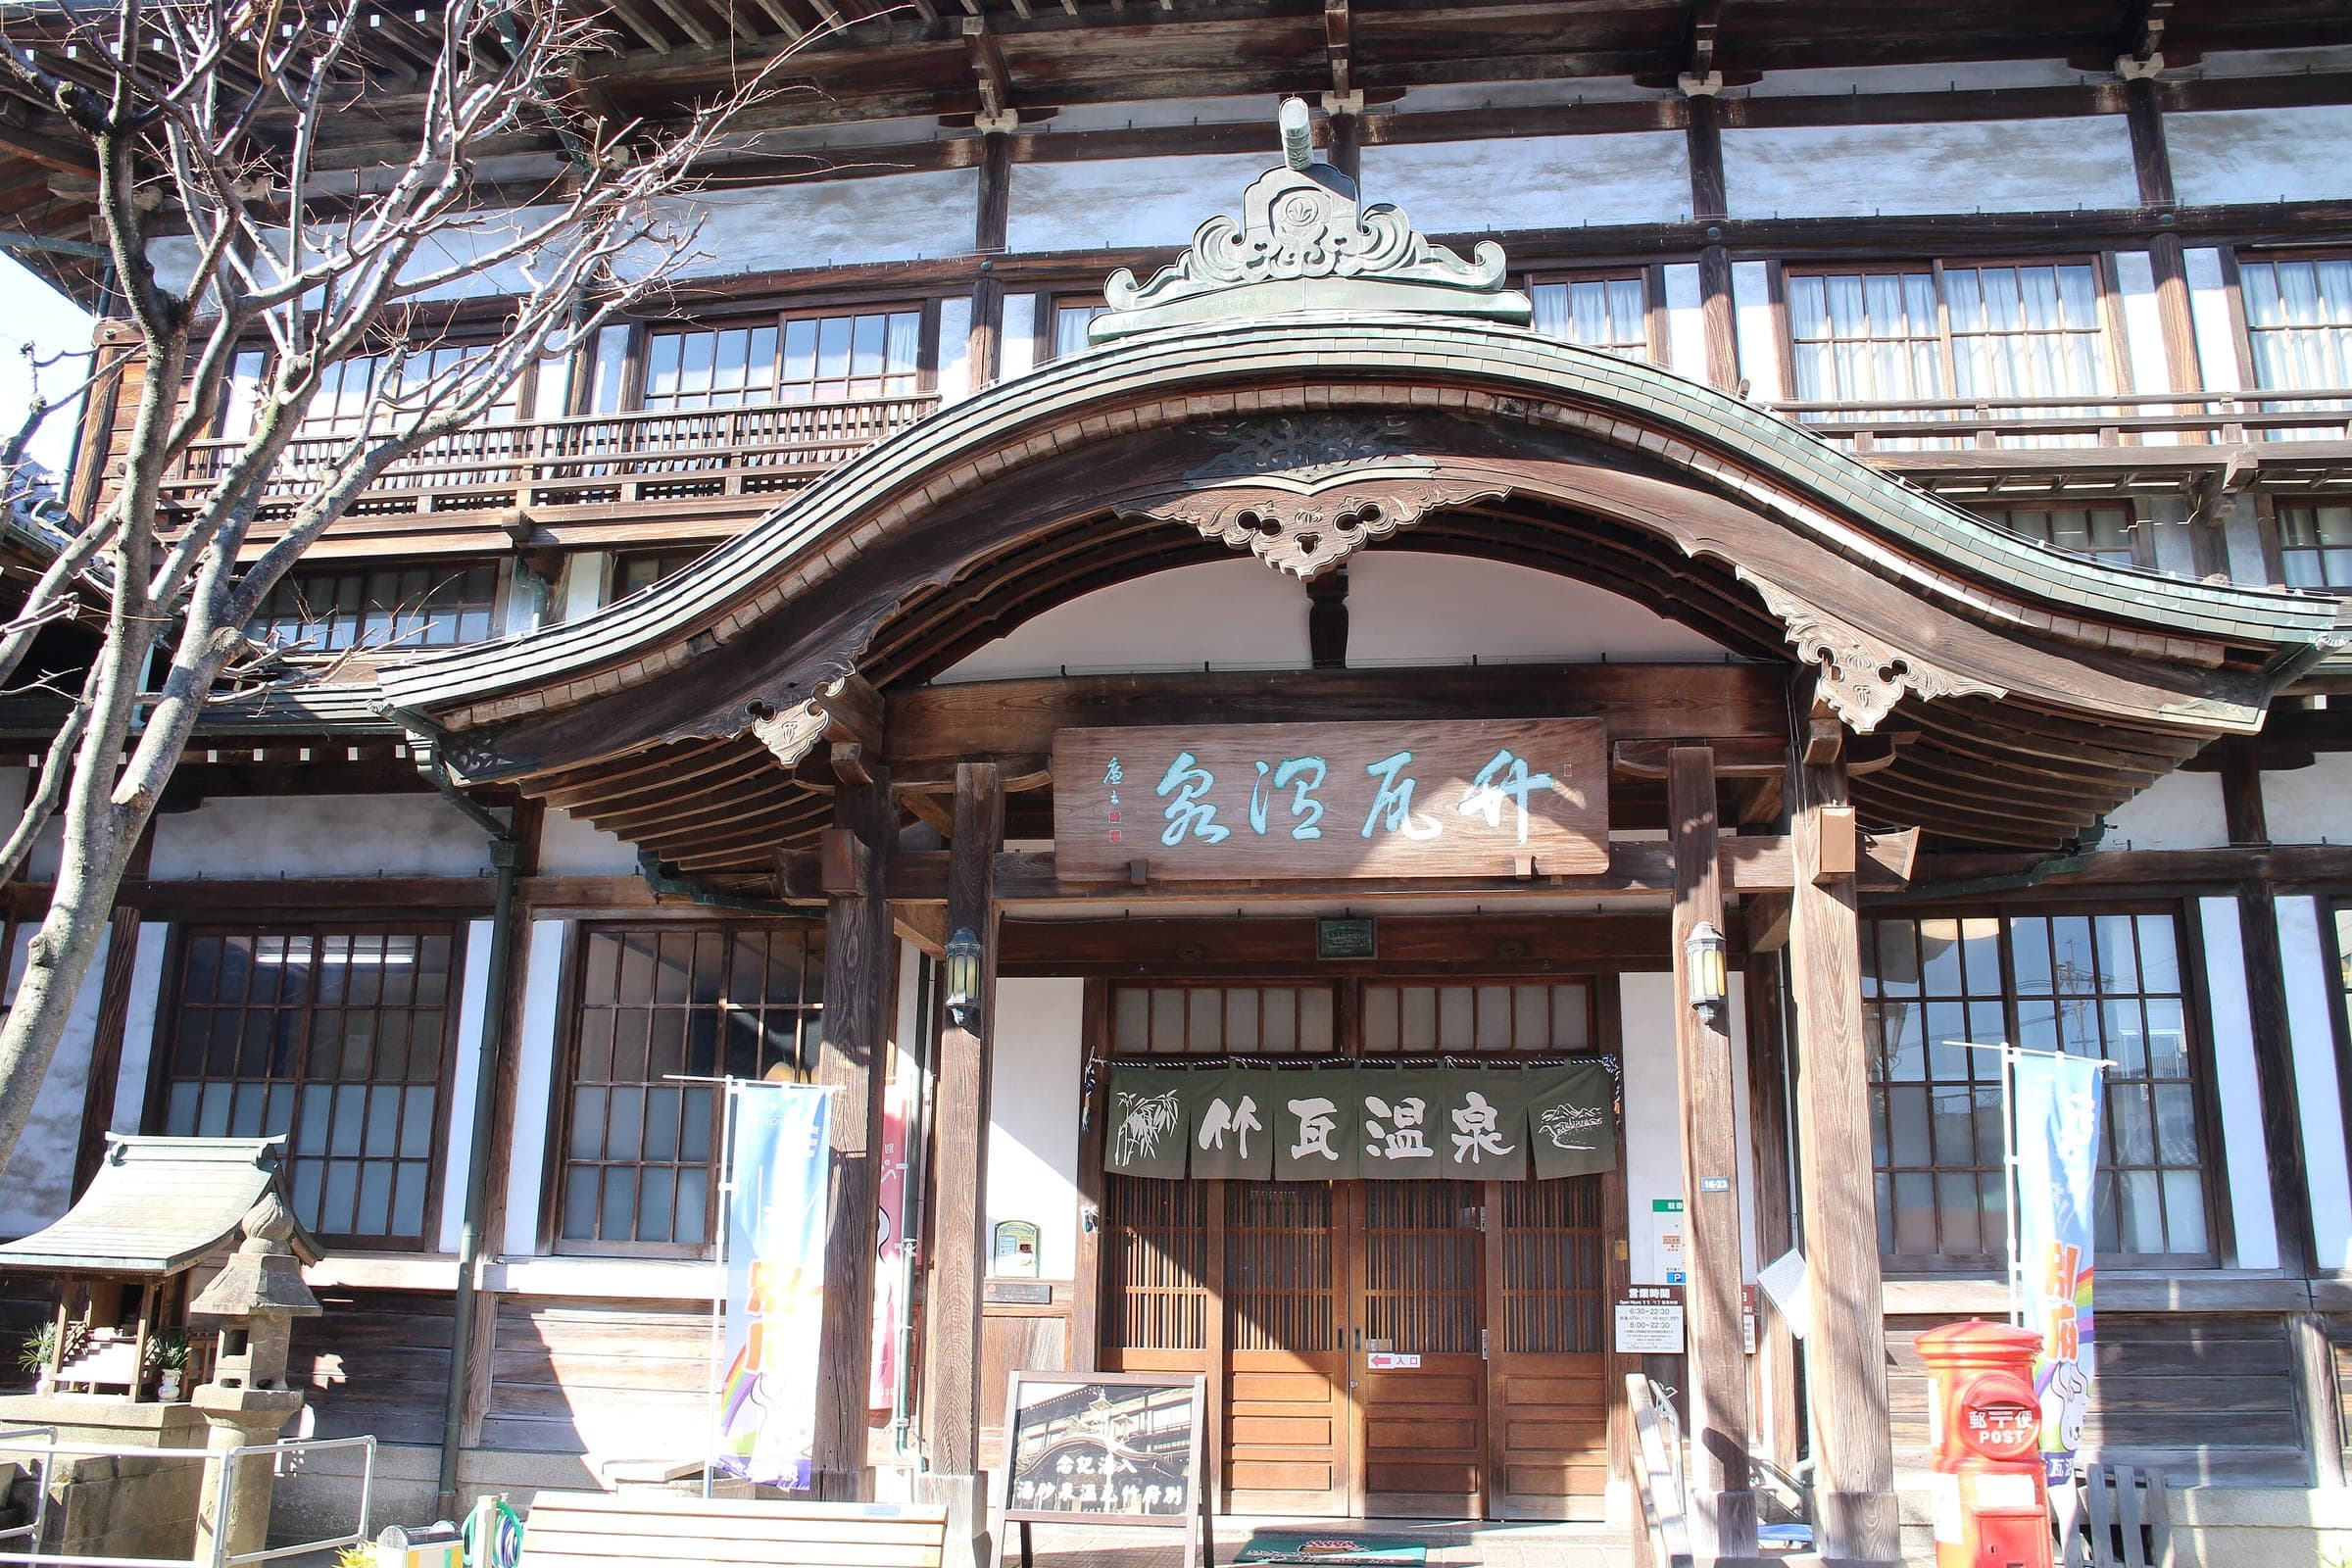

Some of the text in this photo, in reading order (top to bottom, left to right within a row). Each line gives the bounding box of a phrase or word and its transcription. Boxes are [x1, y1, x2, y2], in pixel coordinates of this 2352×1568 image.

[1198, 1091, 1515, 1164] 竹瓦温泉
[1396, 1356, 1418, 1365] 入口
[1979, 1430, 2025, 1445] POST
